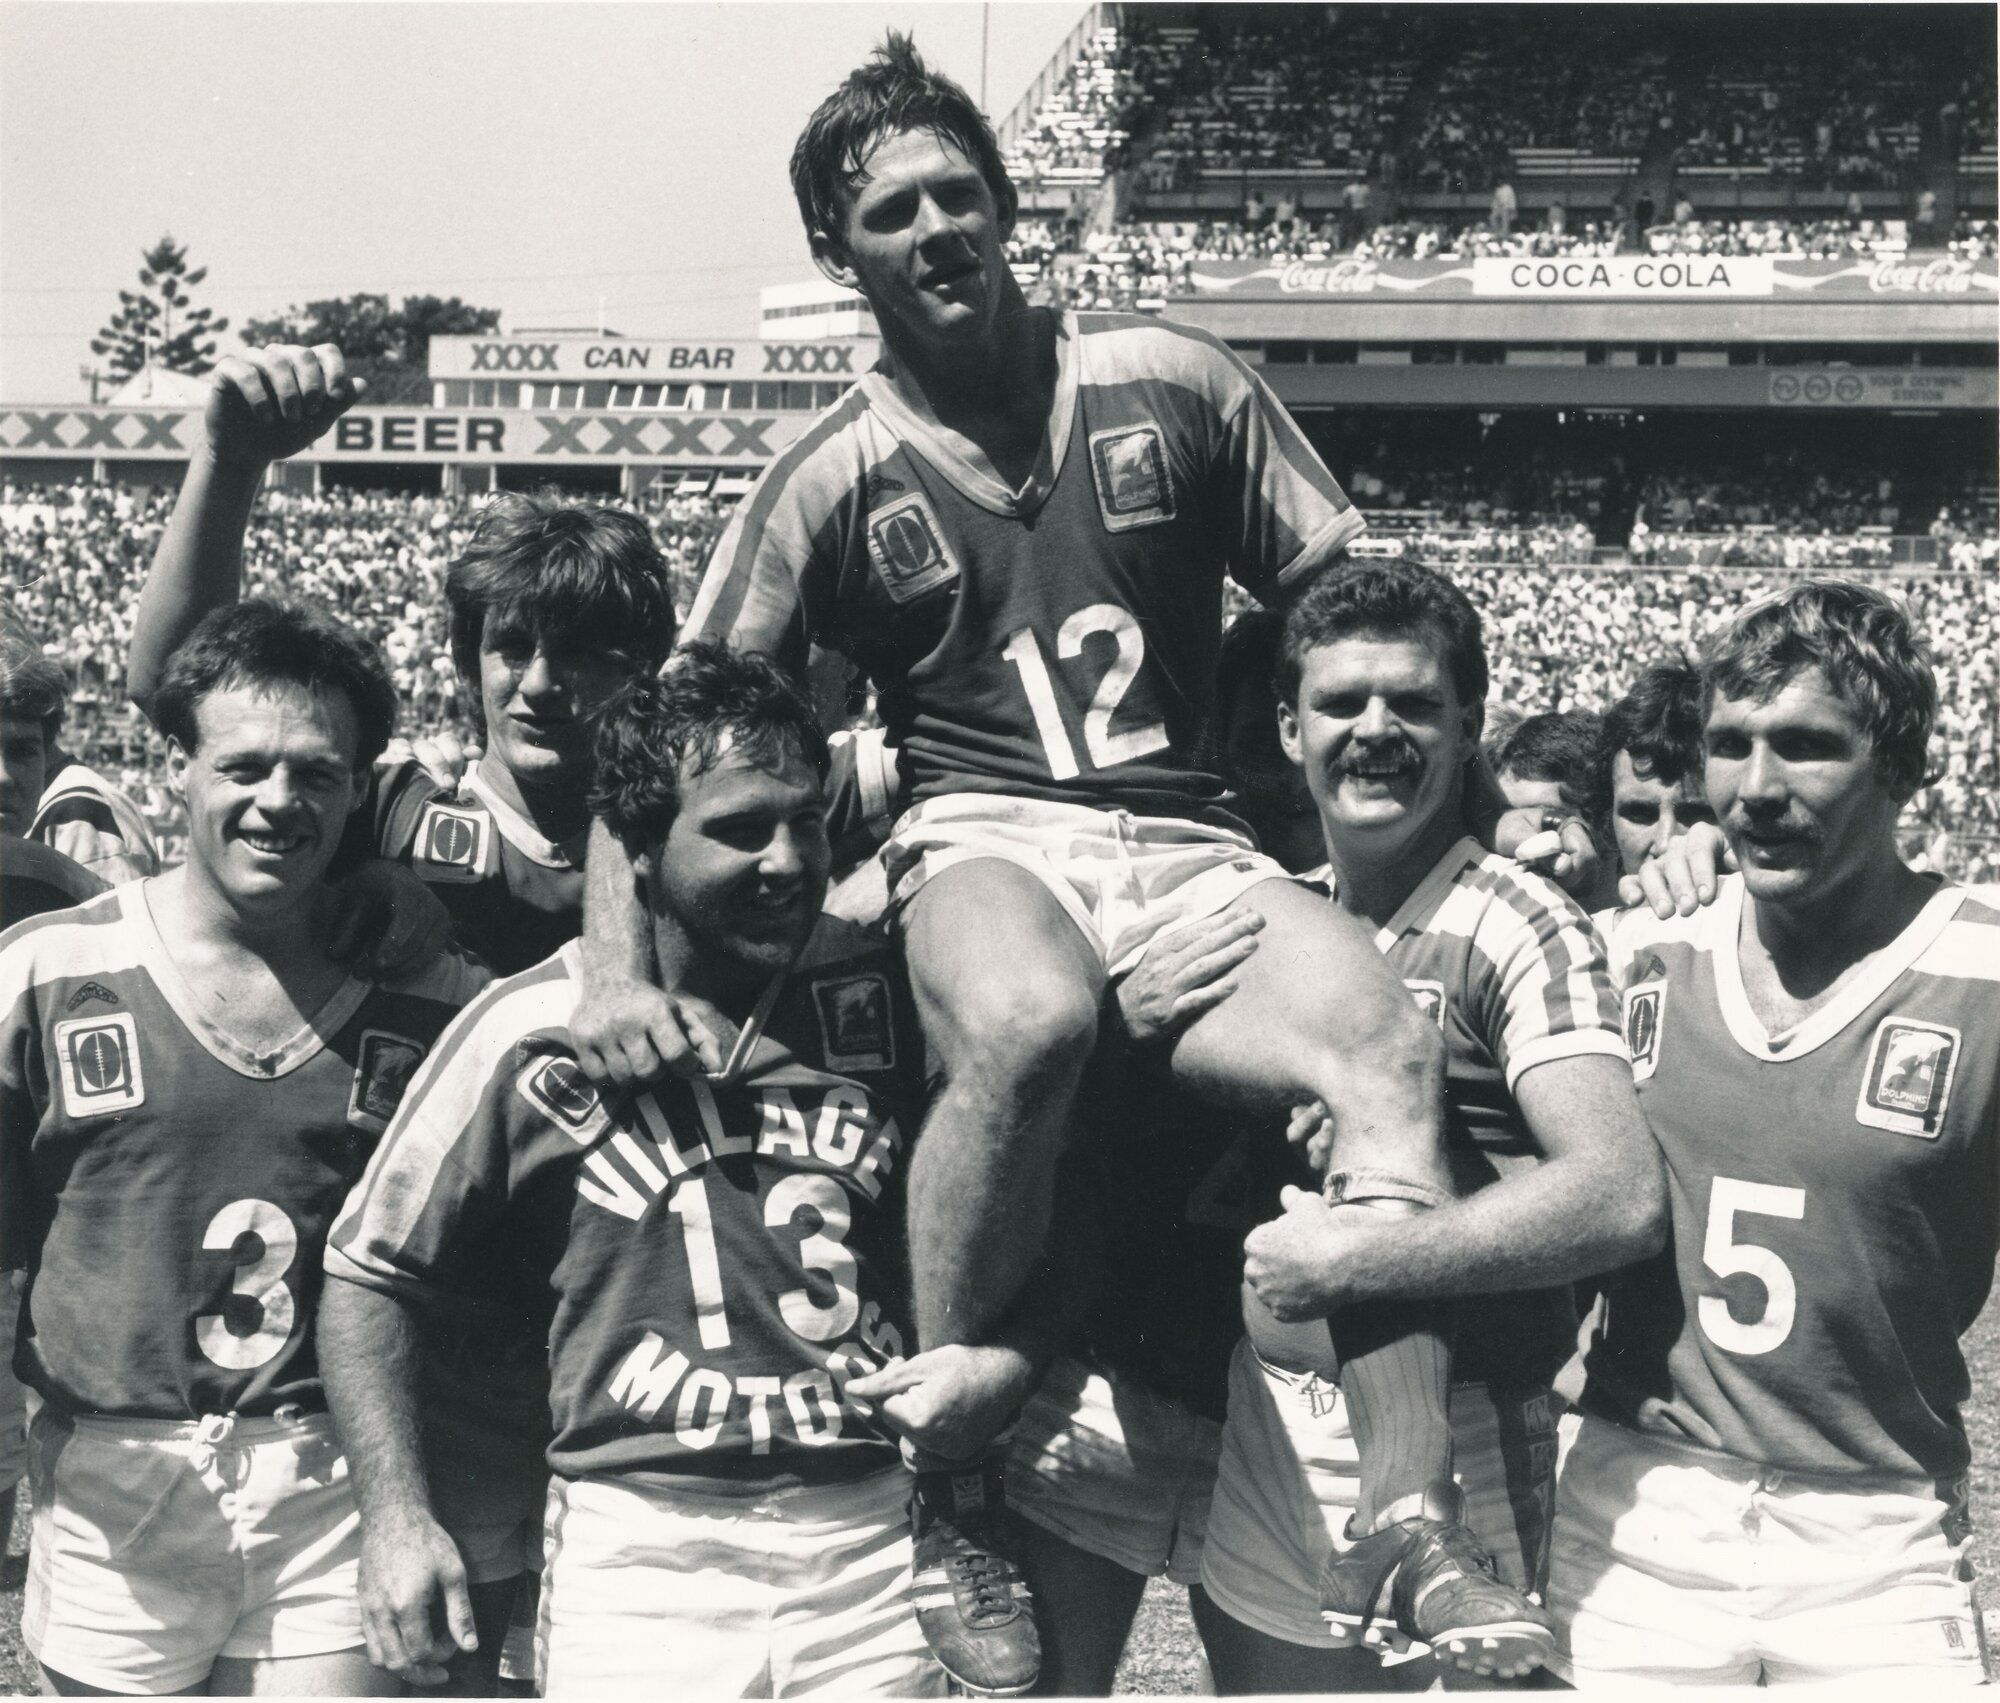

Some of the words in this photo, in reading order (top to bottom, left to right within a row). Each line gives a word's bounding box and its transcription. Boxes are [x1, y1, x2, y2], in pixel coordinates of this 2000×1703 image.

[0, 412, 187, 451] XXX
[336, 416, 505, 453] BEER
[534, 416, 777, 456] XXXX
[471, 344, 559, 371] XXXX
[584, 346, 650, 370] CAN
[668, 346, 734, 370] BAR
[763, 345, 854, 373] XXXX
[1002, 603, 1170, 781] 12
[575, 1079, 903, 1221] VILLAGE
[1881, 1088, 1928, 1105] DOLPHINS
[195, 1199, 298, 1370] 3
[668, 1173, 860, 1350] 13
[1698, 1176, 1806, 1355] 5
